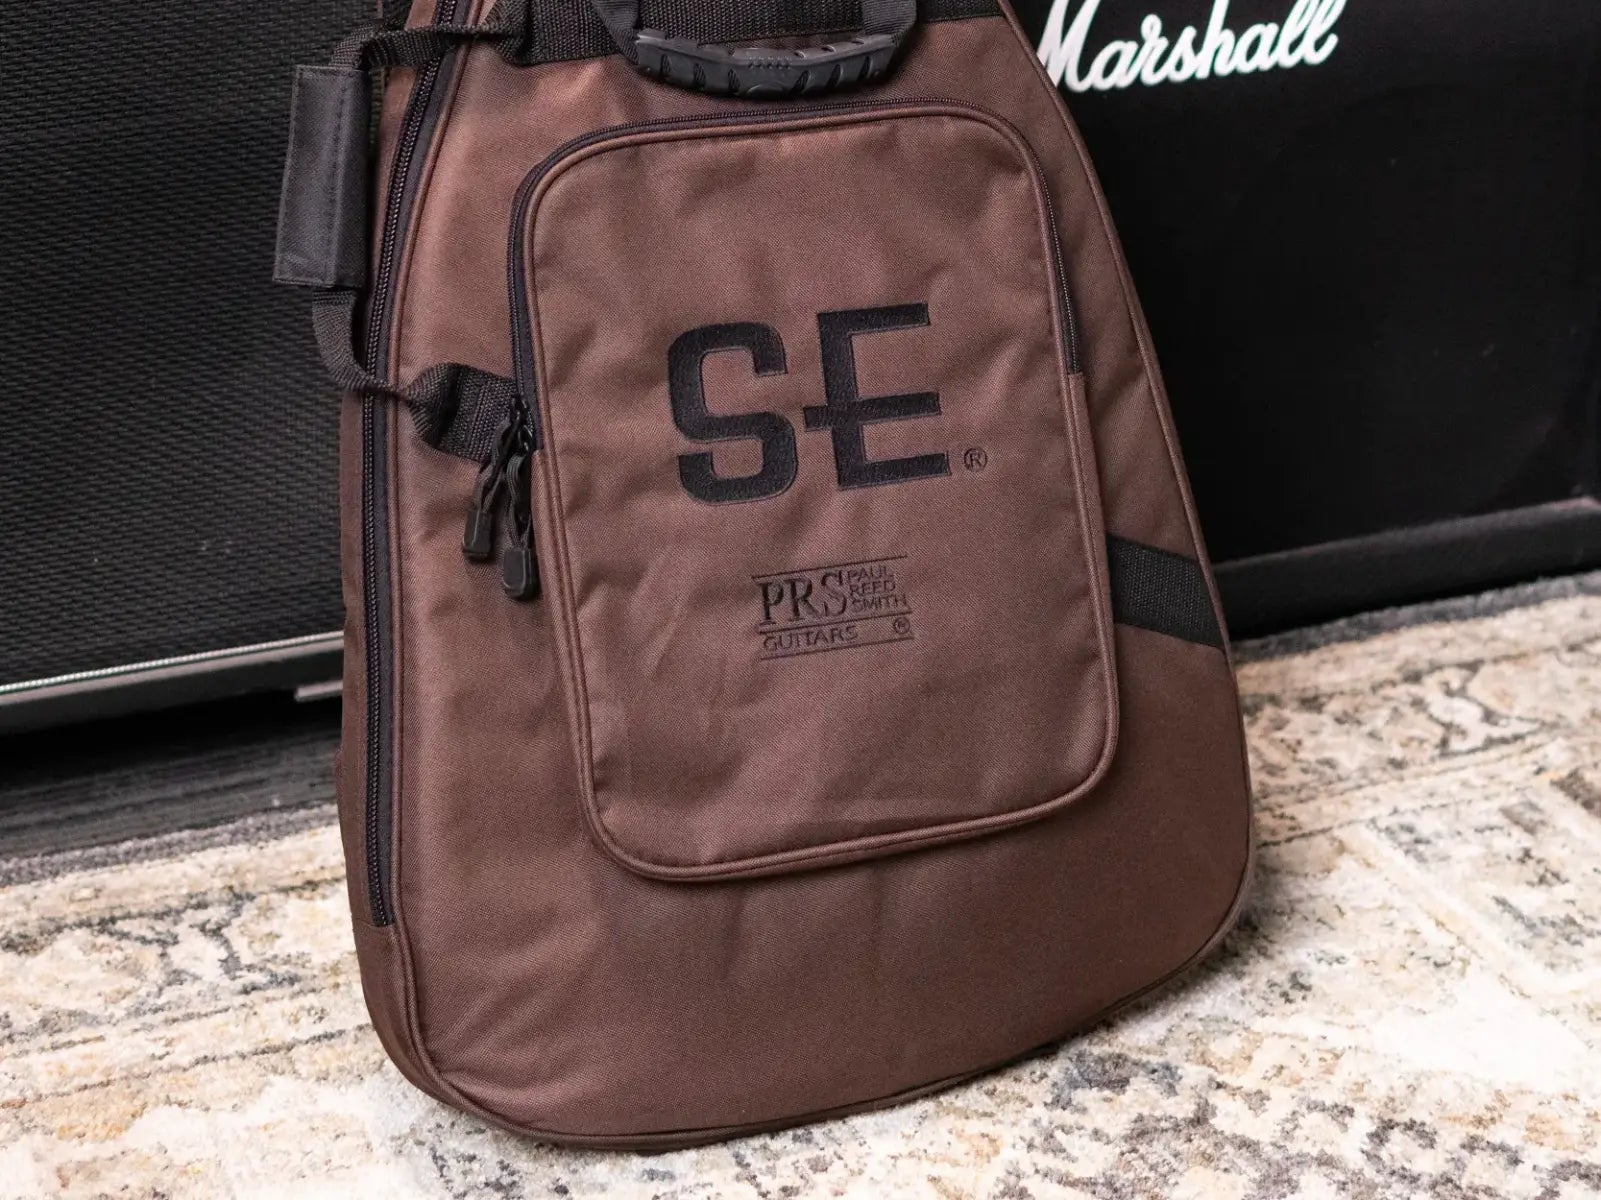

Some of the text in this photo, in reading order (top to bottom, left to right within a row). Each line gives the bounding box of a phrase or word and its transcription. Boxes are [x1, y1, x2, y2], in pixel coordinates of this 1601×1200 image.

[667, 302, 952, 507] SE
[846, 566, 894, 583] PAUL
[757, 570, 849, 626] PRS
[848, 580, 896, 597] REED
[850, 593, 908, 612] SMITH
[762, 625, 859, 652] GUITARS
